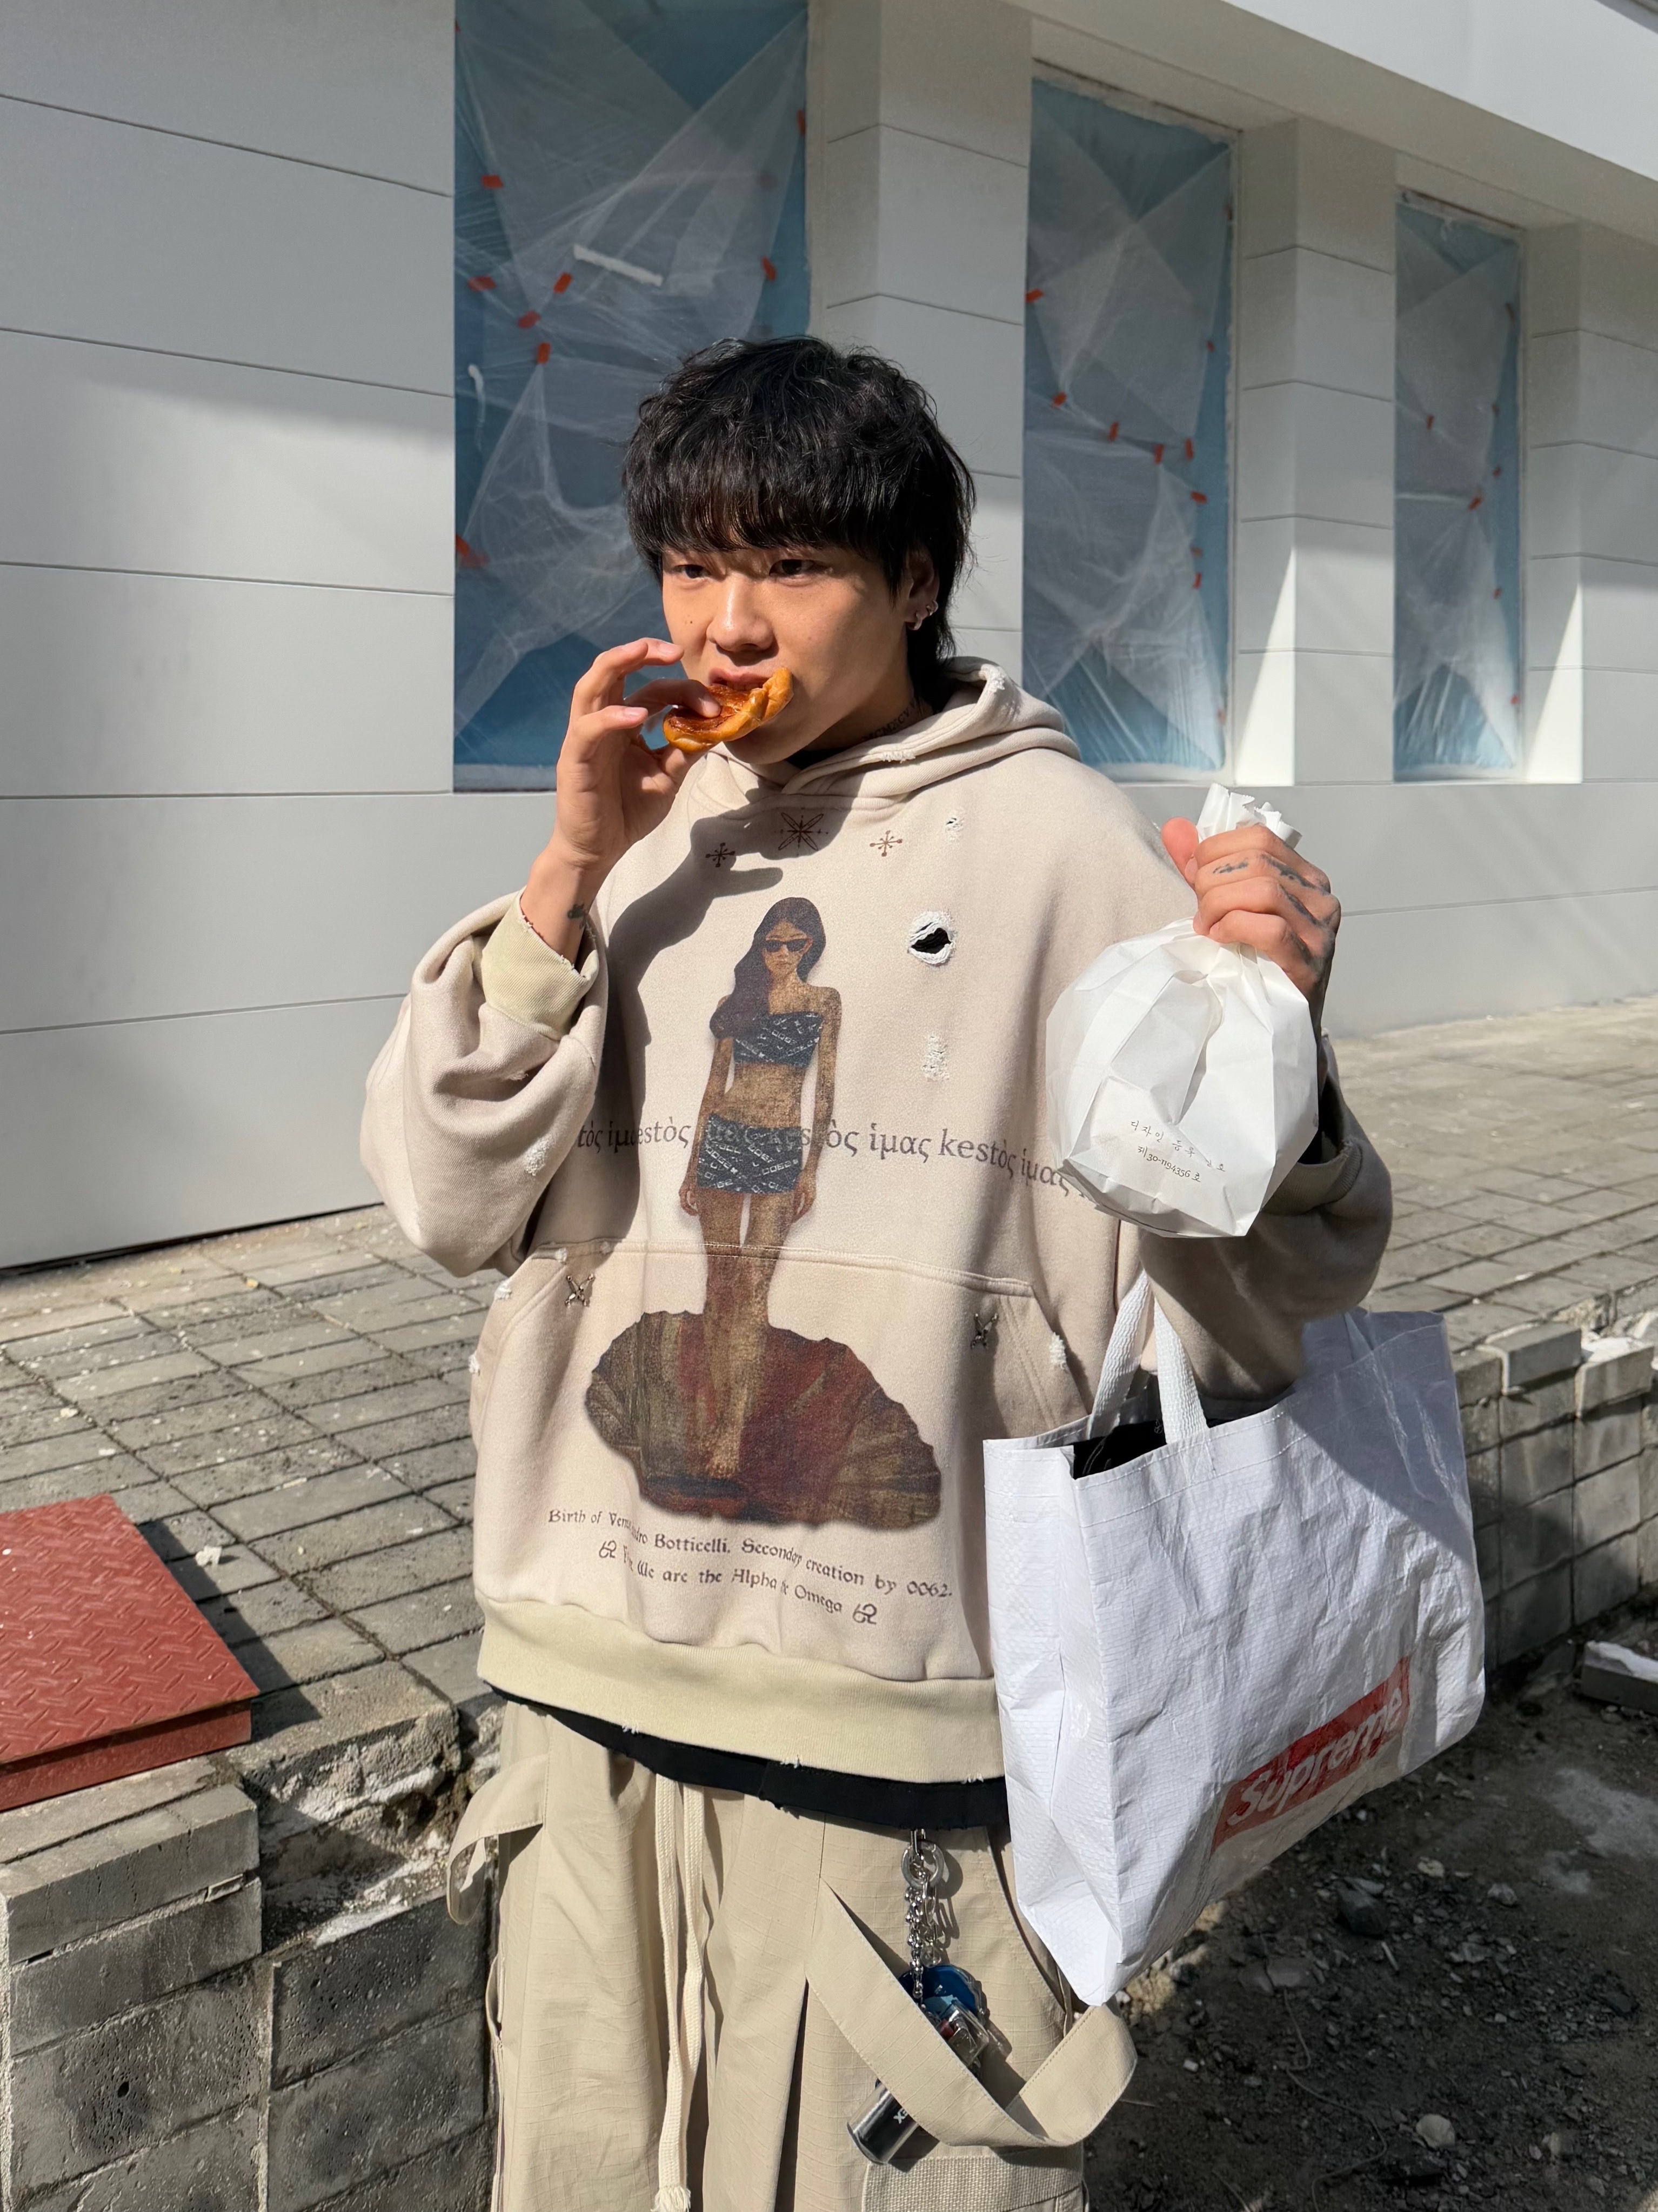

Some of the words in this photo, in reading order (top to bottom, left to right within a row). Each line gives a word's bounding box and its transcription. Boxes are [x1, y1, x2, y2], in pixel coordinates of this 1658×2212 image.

[1131, 1120, 1164, 1143] 디자인
[548, 1509, 586, 1523] Birth
[591, 1511, 603, 1524] of
[609, 1511, 631, 1530] Venu
[654, 1533, 730, 1553] Botticelli.
[806, 1559, 864, 1585] creation
[875, 1574, 897, 1595] by
[663, 1570, 687, 1583] are
[699, 1569, 722, 1583] the
[794, 1584, 842, 1613] Omega
